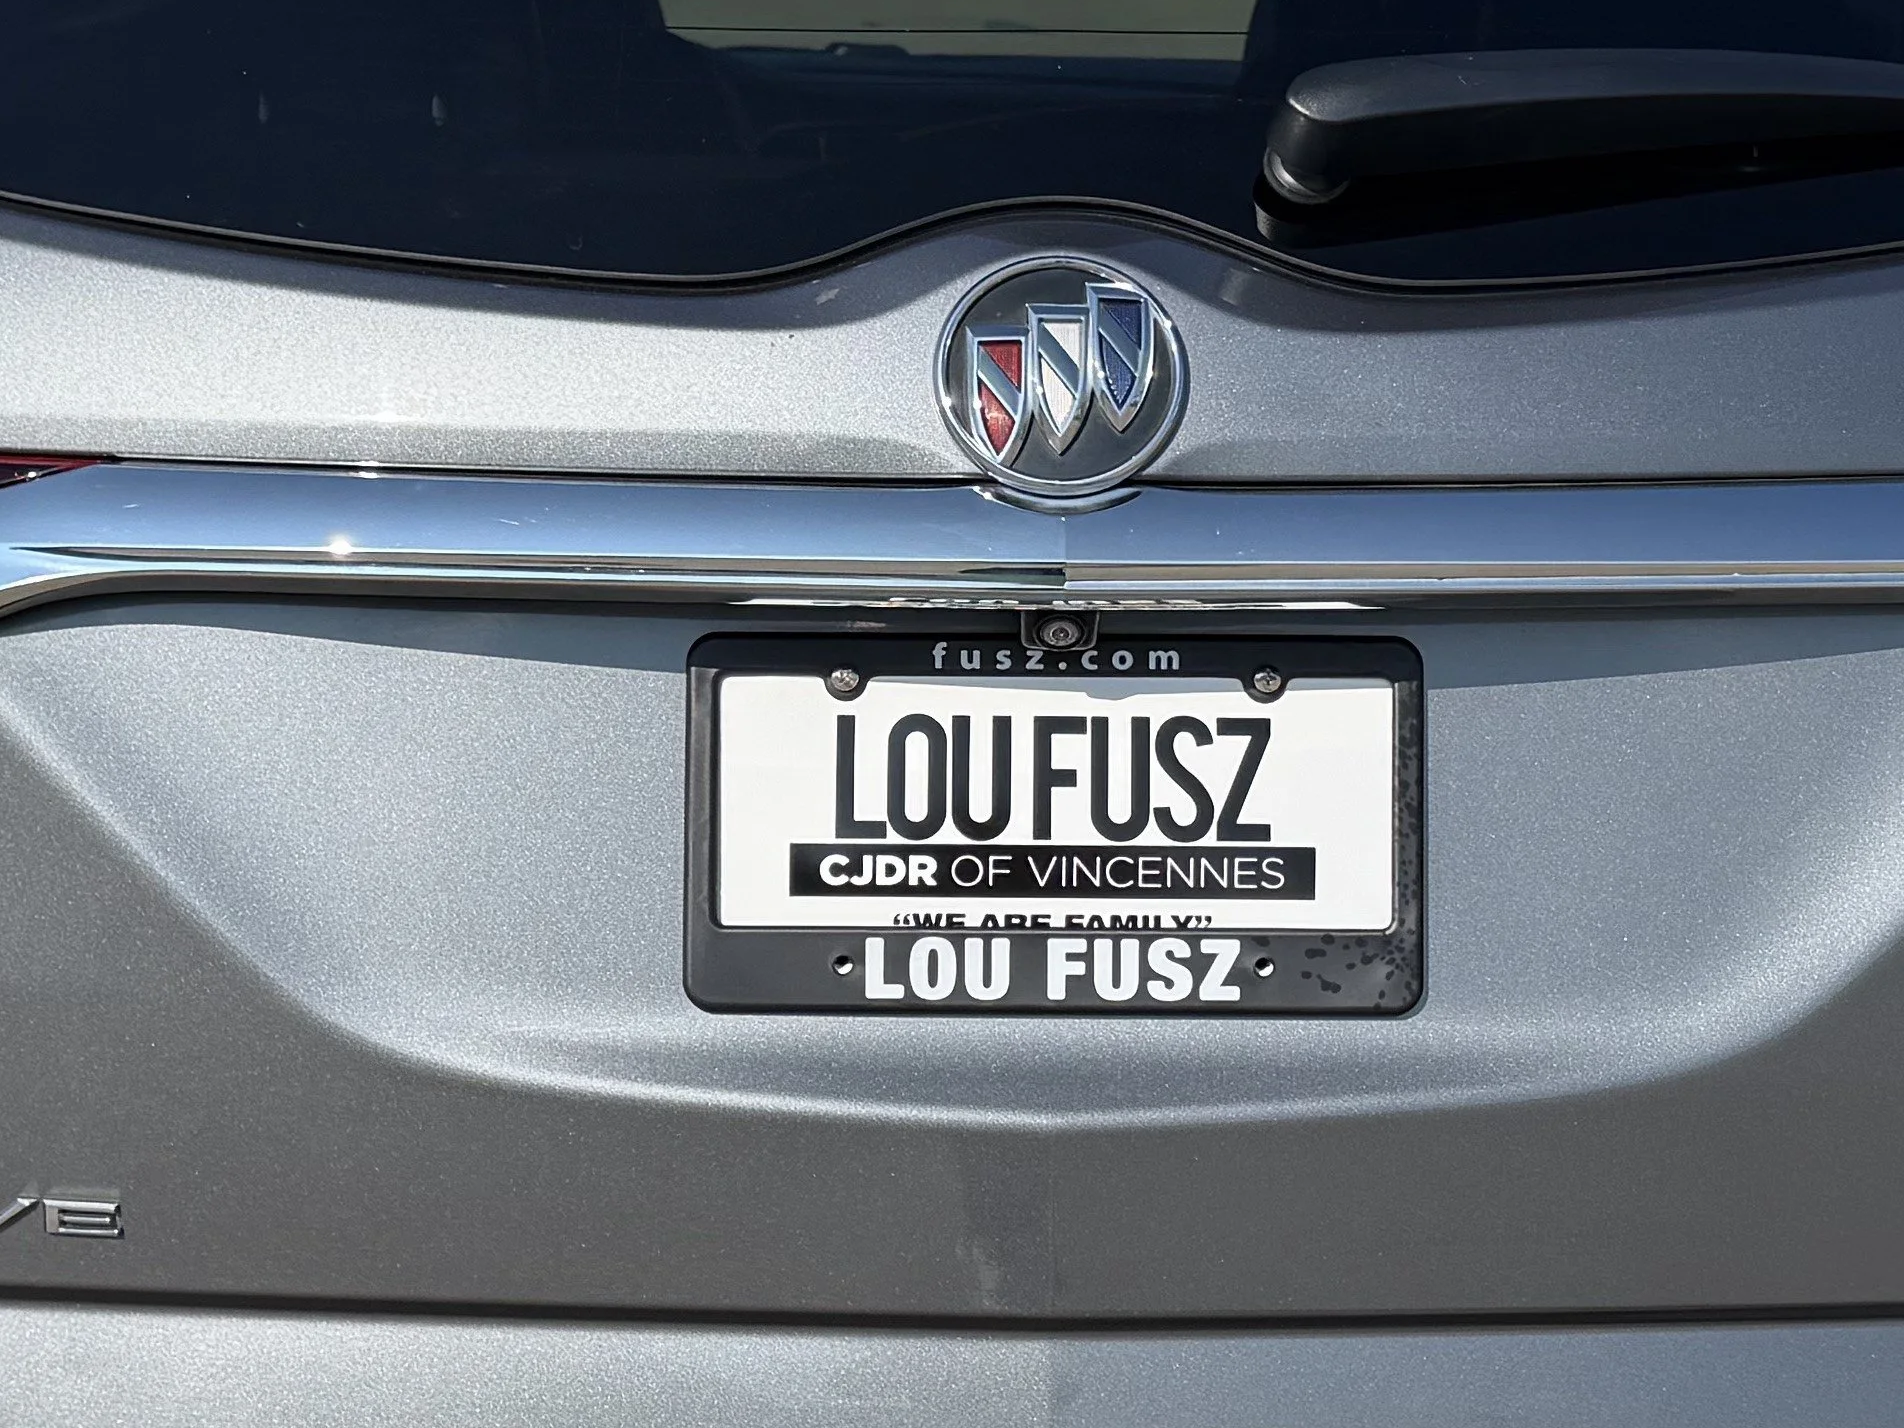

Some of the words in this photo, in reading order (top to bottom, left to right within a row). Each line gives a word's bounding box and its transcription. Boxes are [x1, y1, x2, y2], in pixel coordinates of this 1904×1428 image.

[932, 641, 1180, 671] fusz.com
[835, 713, 1012, 842] LOU
[1032, 714, 1272, 843] FUSZ
[818, 854, 938, 887] CJDR
[950, 855, 1013, 888] OF
[1027, 856, 1285, 890] VINCENNES
[864, 937, 1011, 1001] LOU
[1046, 937, 1242, 1002] FUSZ
